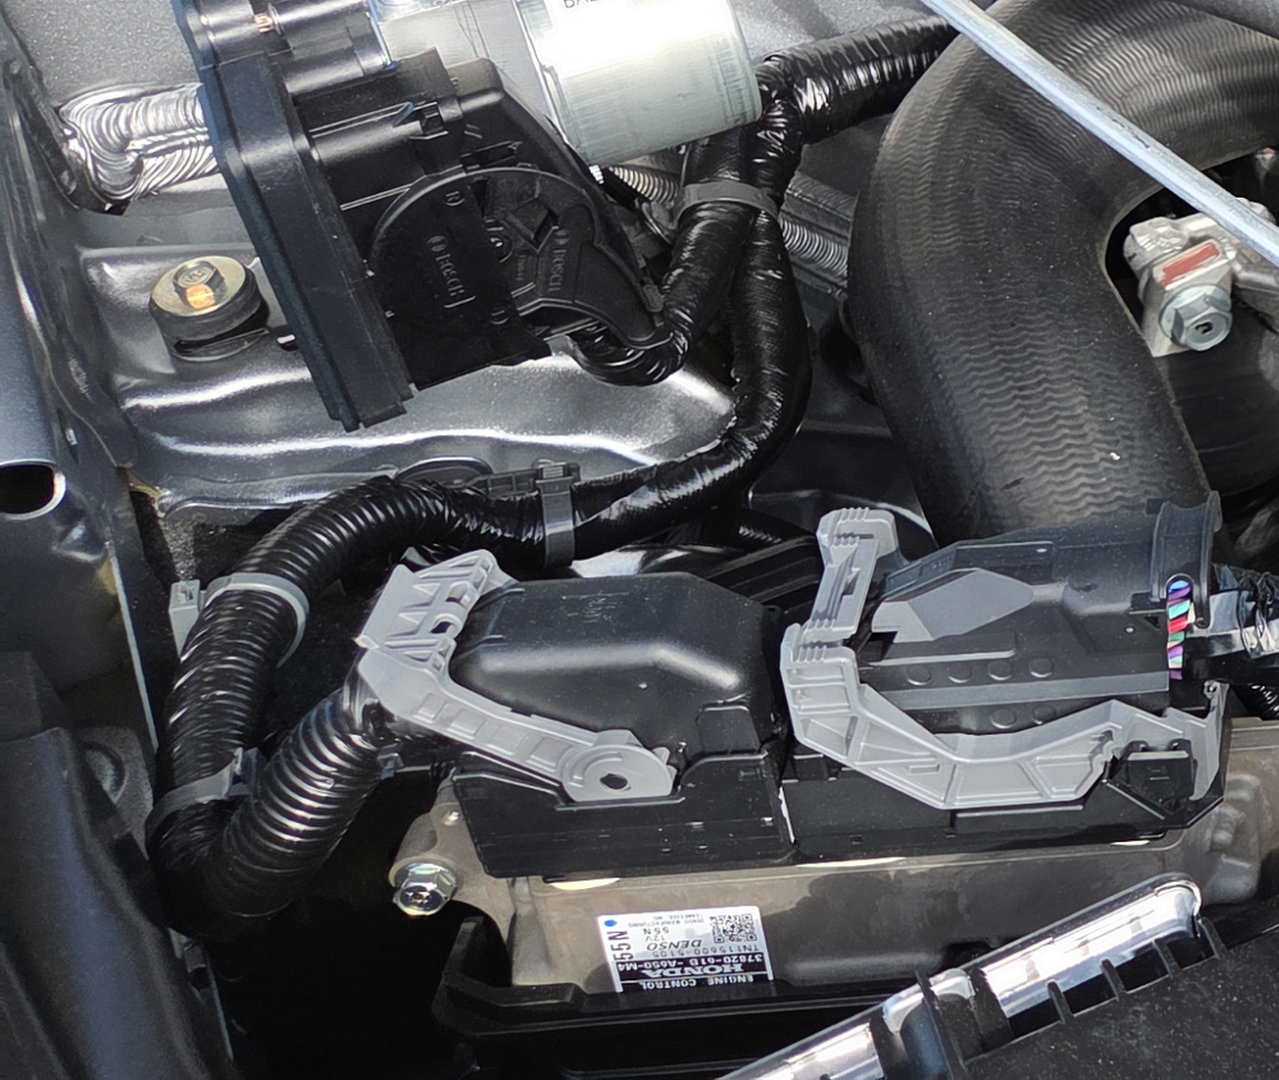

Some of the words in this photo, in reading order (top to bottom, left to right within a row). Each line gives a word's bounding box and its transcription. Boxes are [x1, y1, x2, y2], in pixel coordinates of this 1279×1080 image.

[606, 929, 634, 962] 55N
[646, 939, 703, 952] DENSO
[641, 963, 744, 979] HONDA
[639, 978, 698, 991] CONTROL
[707, 974, 754, 985] ENGINE
